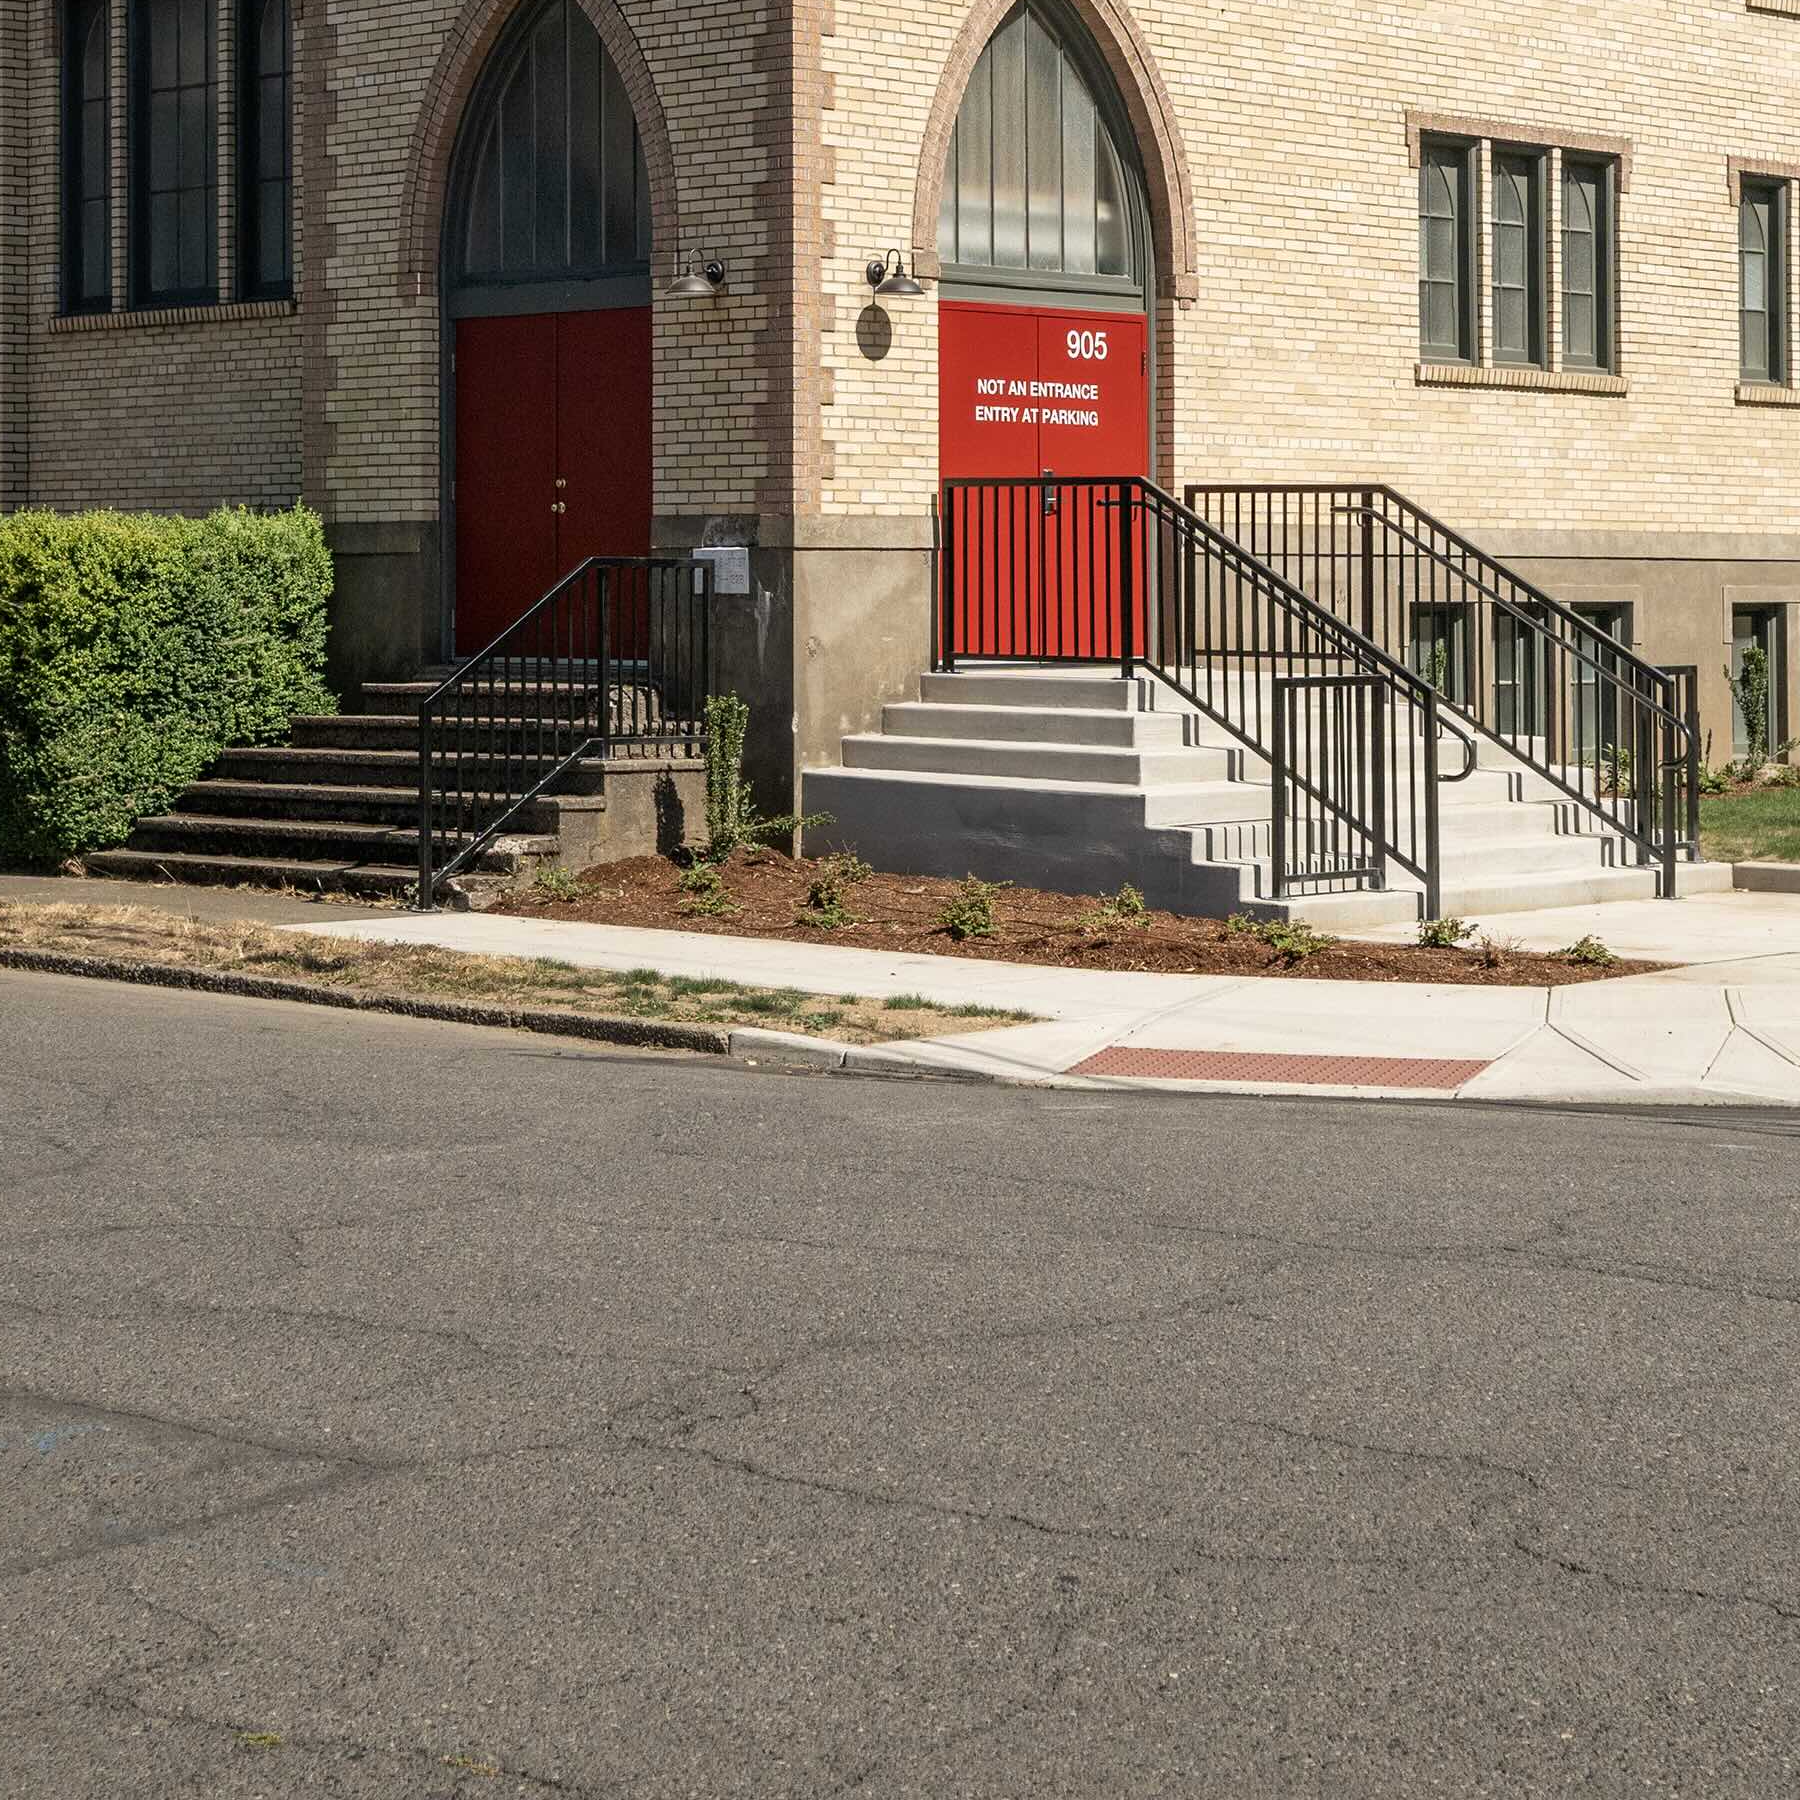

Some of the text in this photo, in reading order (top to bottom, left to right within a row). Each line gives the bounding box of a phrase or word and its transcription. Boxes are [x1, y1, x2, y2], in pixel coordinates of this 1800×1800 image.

[1066, 330, 1108, 360] 905
[977, 379, 1099, 400] NOT AN ENTRANCE
[975, 406, 1099, 426] ENTRY AT PARKING
